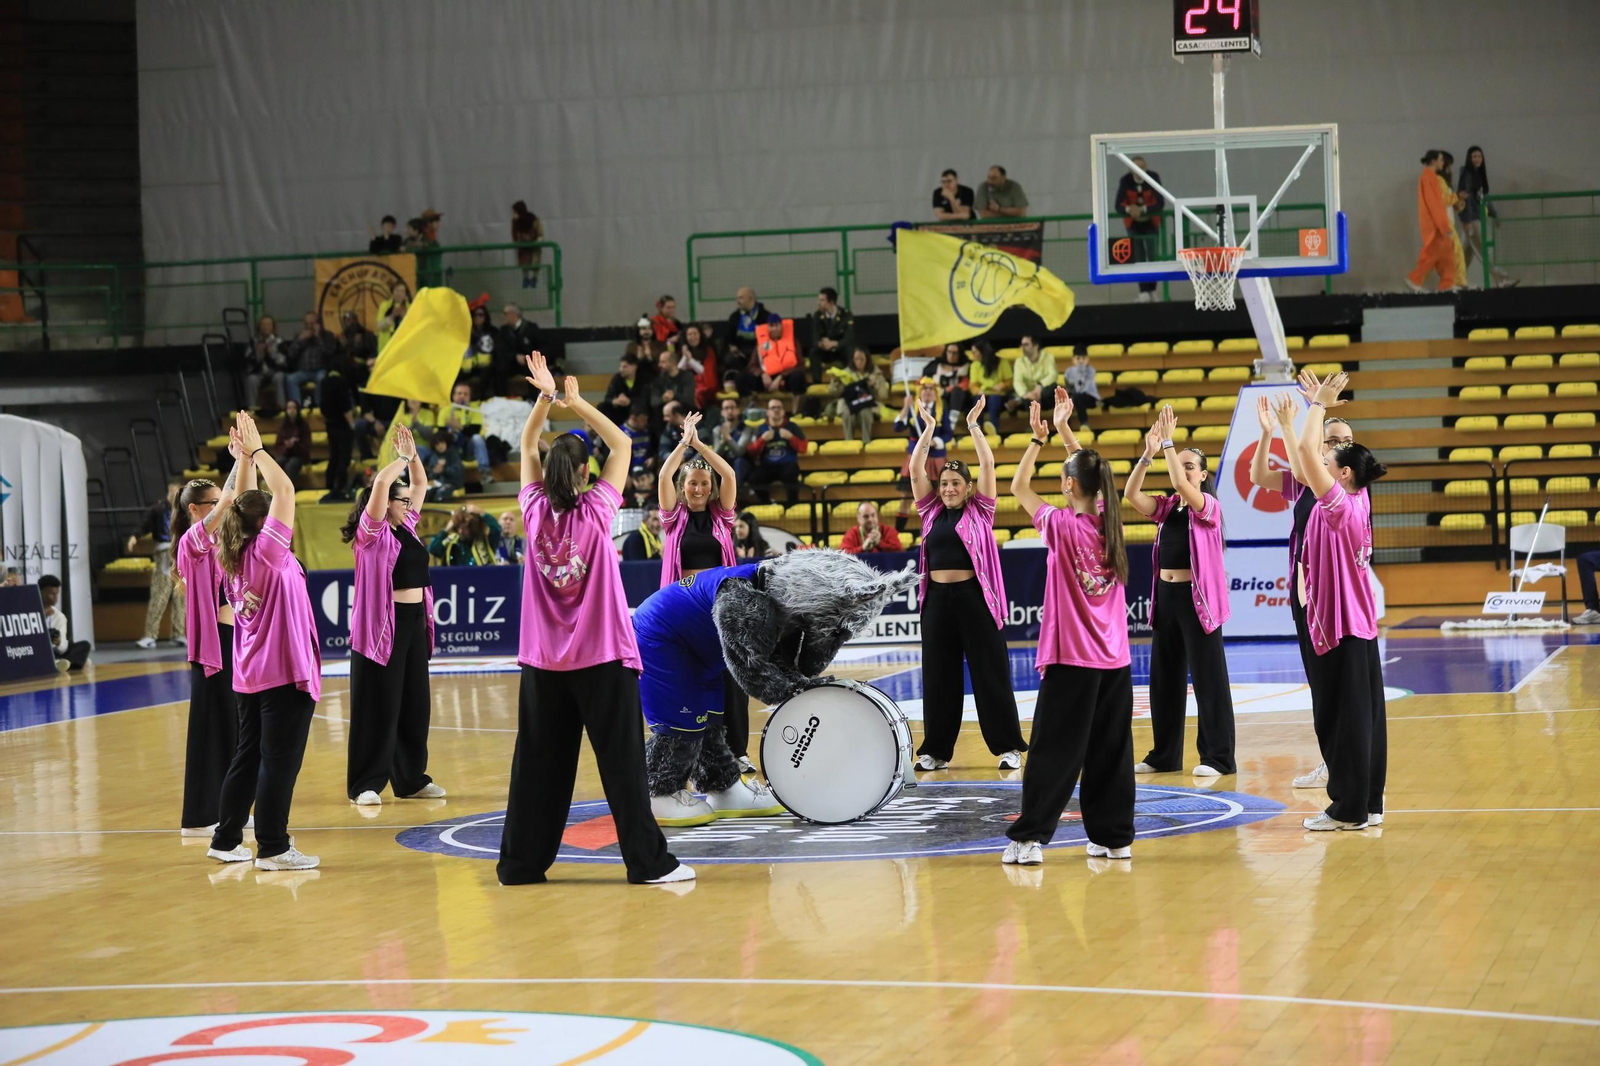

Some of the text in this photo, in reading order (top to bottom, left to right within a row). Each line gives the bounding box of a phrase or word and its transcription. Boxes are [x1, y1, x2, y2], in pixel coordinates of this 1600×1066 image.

[1185, 0, 1240, 34] 24
[5, 541, 79, 560] NZÁLEZ
[1231, 577, 1291, 590] BricoC
[433, 584, 506, 626] diz
[440, 631, 500, 642] SEGUROS
[447, 645, 480, 653] Ourense
